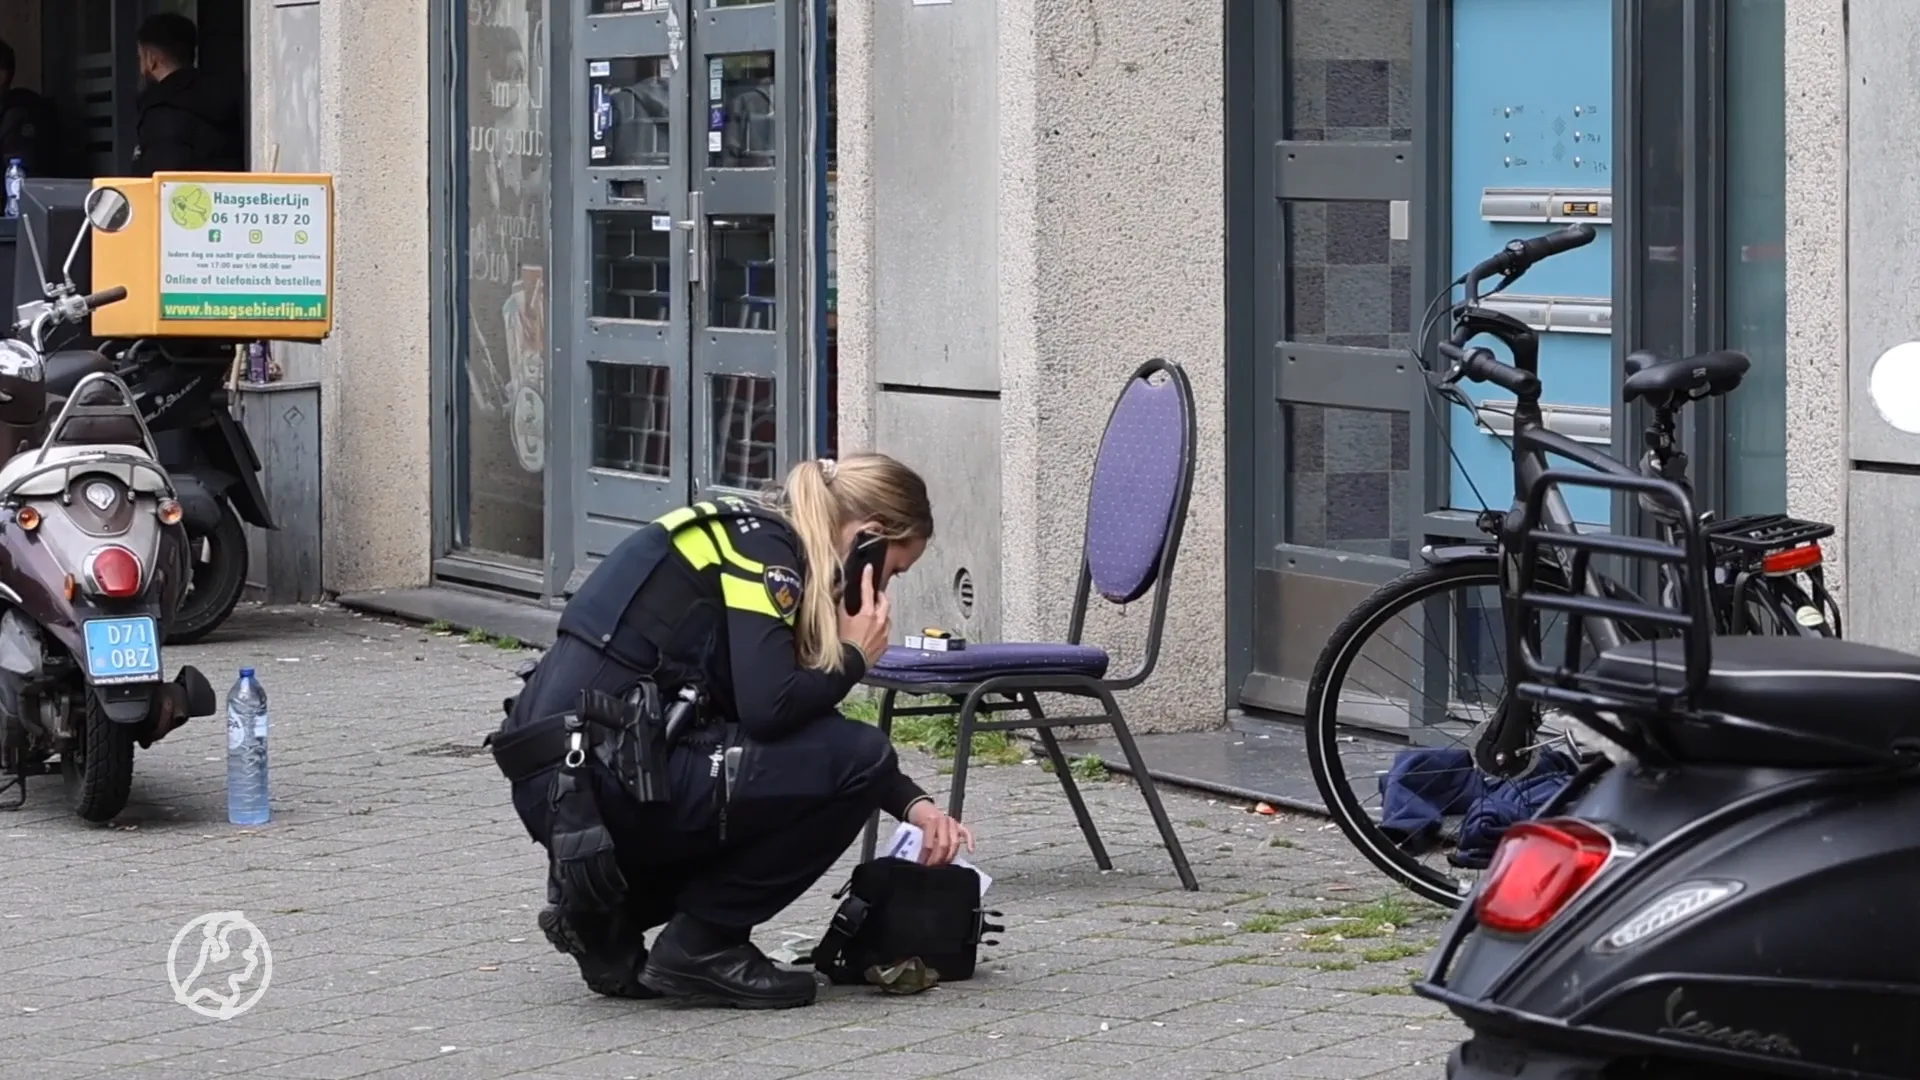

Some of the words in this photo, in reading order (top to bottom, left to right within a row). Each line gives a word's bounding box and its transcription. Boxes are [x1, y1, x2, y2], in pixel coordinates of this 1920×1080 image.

[214, 192, 309, 209] HaagseBierLijn
[211, 213, 228, 224] 06
[234, 213, 258, 224] 170
[265, 213, 288, 225] 187
[294, 214, 310, 225] 20
[165, 274, 198, 285] Online
[201, 274, 212, 285] of
[216, 275, 271, 286] telefonisch
[275, 276, 322, 286] bestellen
[165, 301, 321, 319] www.haagsebierlijn.nl
[108, 624, 146, 645] D71
